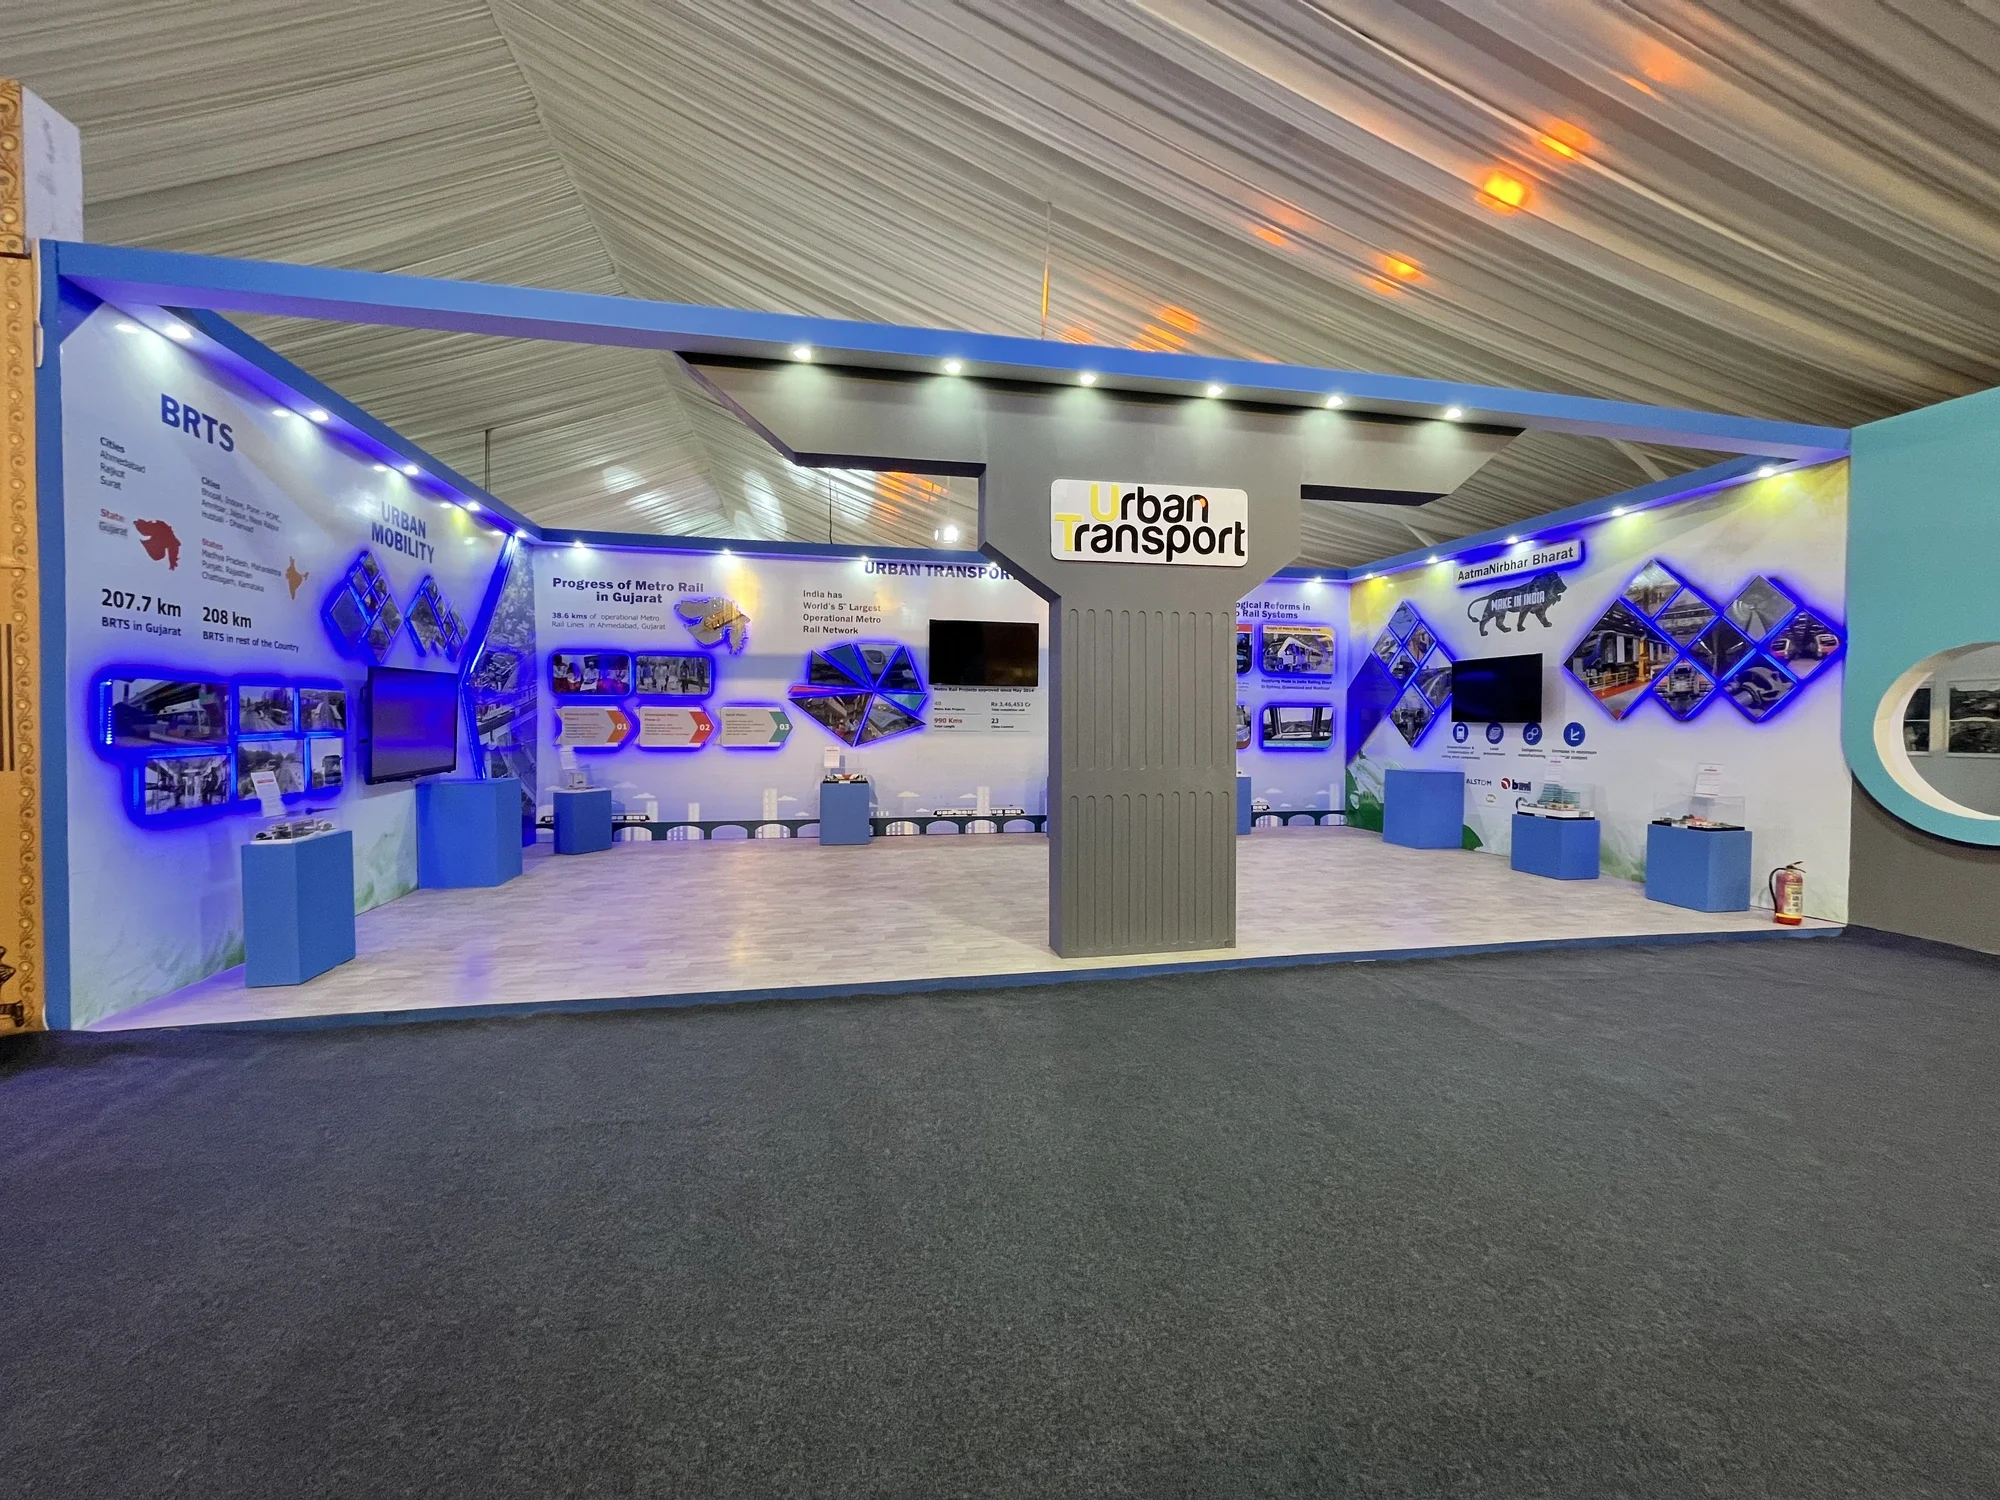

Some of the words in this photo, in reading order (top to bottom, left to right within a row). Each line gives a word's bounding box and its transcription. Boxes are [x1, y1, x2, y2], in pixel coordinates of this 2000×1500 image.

[161, 393, 235, 453] BRTS
[100, 437, 125, 453] Cities
[100, 476, 122, 490] Surat
[202, 476, 220, 490] Cities
[1090, 482, 1209, 524] Urban
[382, 500, 426, 540] URBAN
[372, 521, 434, 564] MOBILITY
[1054, 513, 1245, 562] Transport
[864, 562, 921, 576] URBAN
[924, 564, 1016, 580] TRANSPOR
[1458, 558, 1528, 581] AatmaNirbhar
[1532, 546, 1574, 566] Bharat
[552, 577, 614, 590] Progress
[618, 580, 632, 590] of
[636, 580, 674, 592] Metro
[678, 582, 704, 592] Rail
[596, 592, 608, 602] in
[612, 592, 662, 604] Gujarat
[803, 590, 825, 598] India
[827, 590, 842, 598] has
[1492, 596, 1512, 610] MAKE
[1514, 594, 1522, 607] IN
[1523, 590, 1544, 606] INDIA
[102, 588, 152, 612] 207.7
[157, 597, 182, 618] km
[803, 602, 836, 610] World's
[850, 603, 881, 612] Largest
[1264, 602, 1300, 610] Reforms
[202, 606, 228, 624] 208
[232, 612, 252, 628] km
[590, 612, 597, 620] of
[600, 614, 638, 622] operational
[803, 614, 854, 622] Operational
[856, 616, 881, 624] Metro
[1242, 610, 1260, 618] Rail
[1262, 611, 1298, 619] Systems
[102, 616, 130, 630] BRTS
[133, 620, 142, 632] in
[146, 622, 182, 637] Gujarat
[552, 620, 564, 628] Rail
[598, 622, 639, 630] Ahmedabad,
[641, 622, 666, 631] Gujarat
[803, 625, 820, 633] Rail
[822, 626, 858, 634] Network
[202, 630, 224, 642] BRTS
[226, 634, 234, 644] in
[236, 636, 250, 646] rest
[252, 637, 260, 647] of
[260, 639, 273, 648] the
[274, 640, 300, 653] Country
[1466, 778, 1492, 786] ALSTOM
